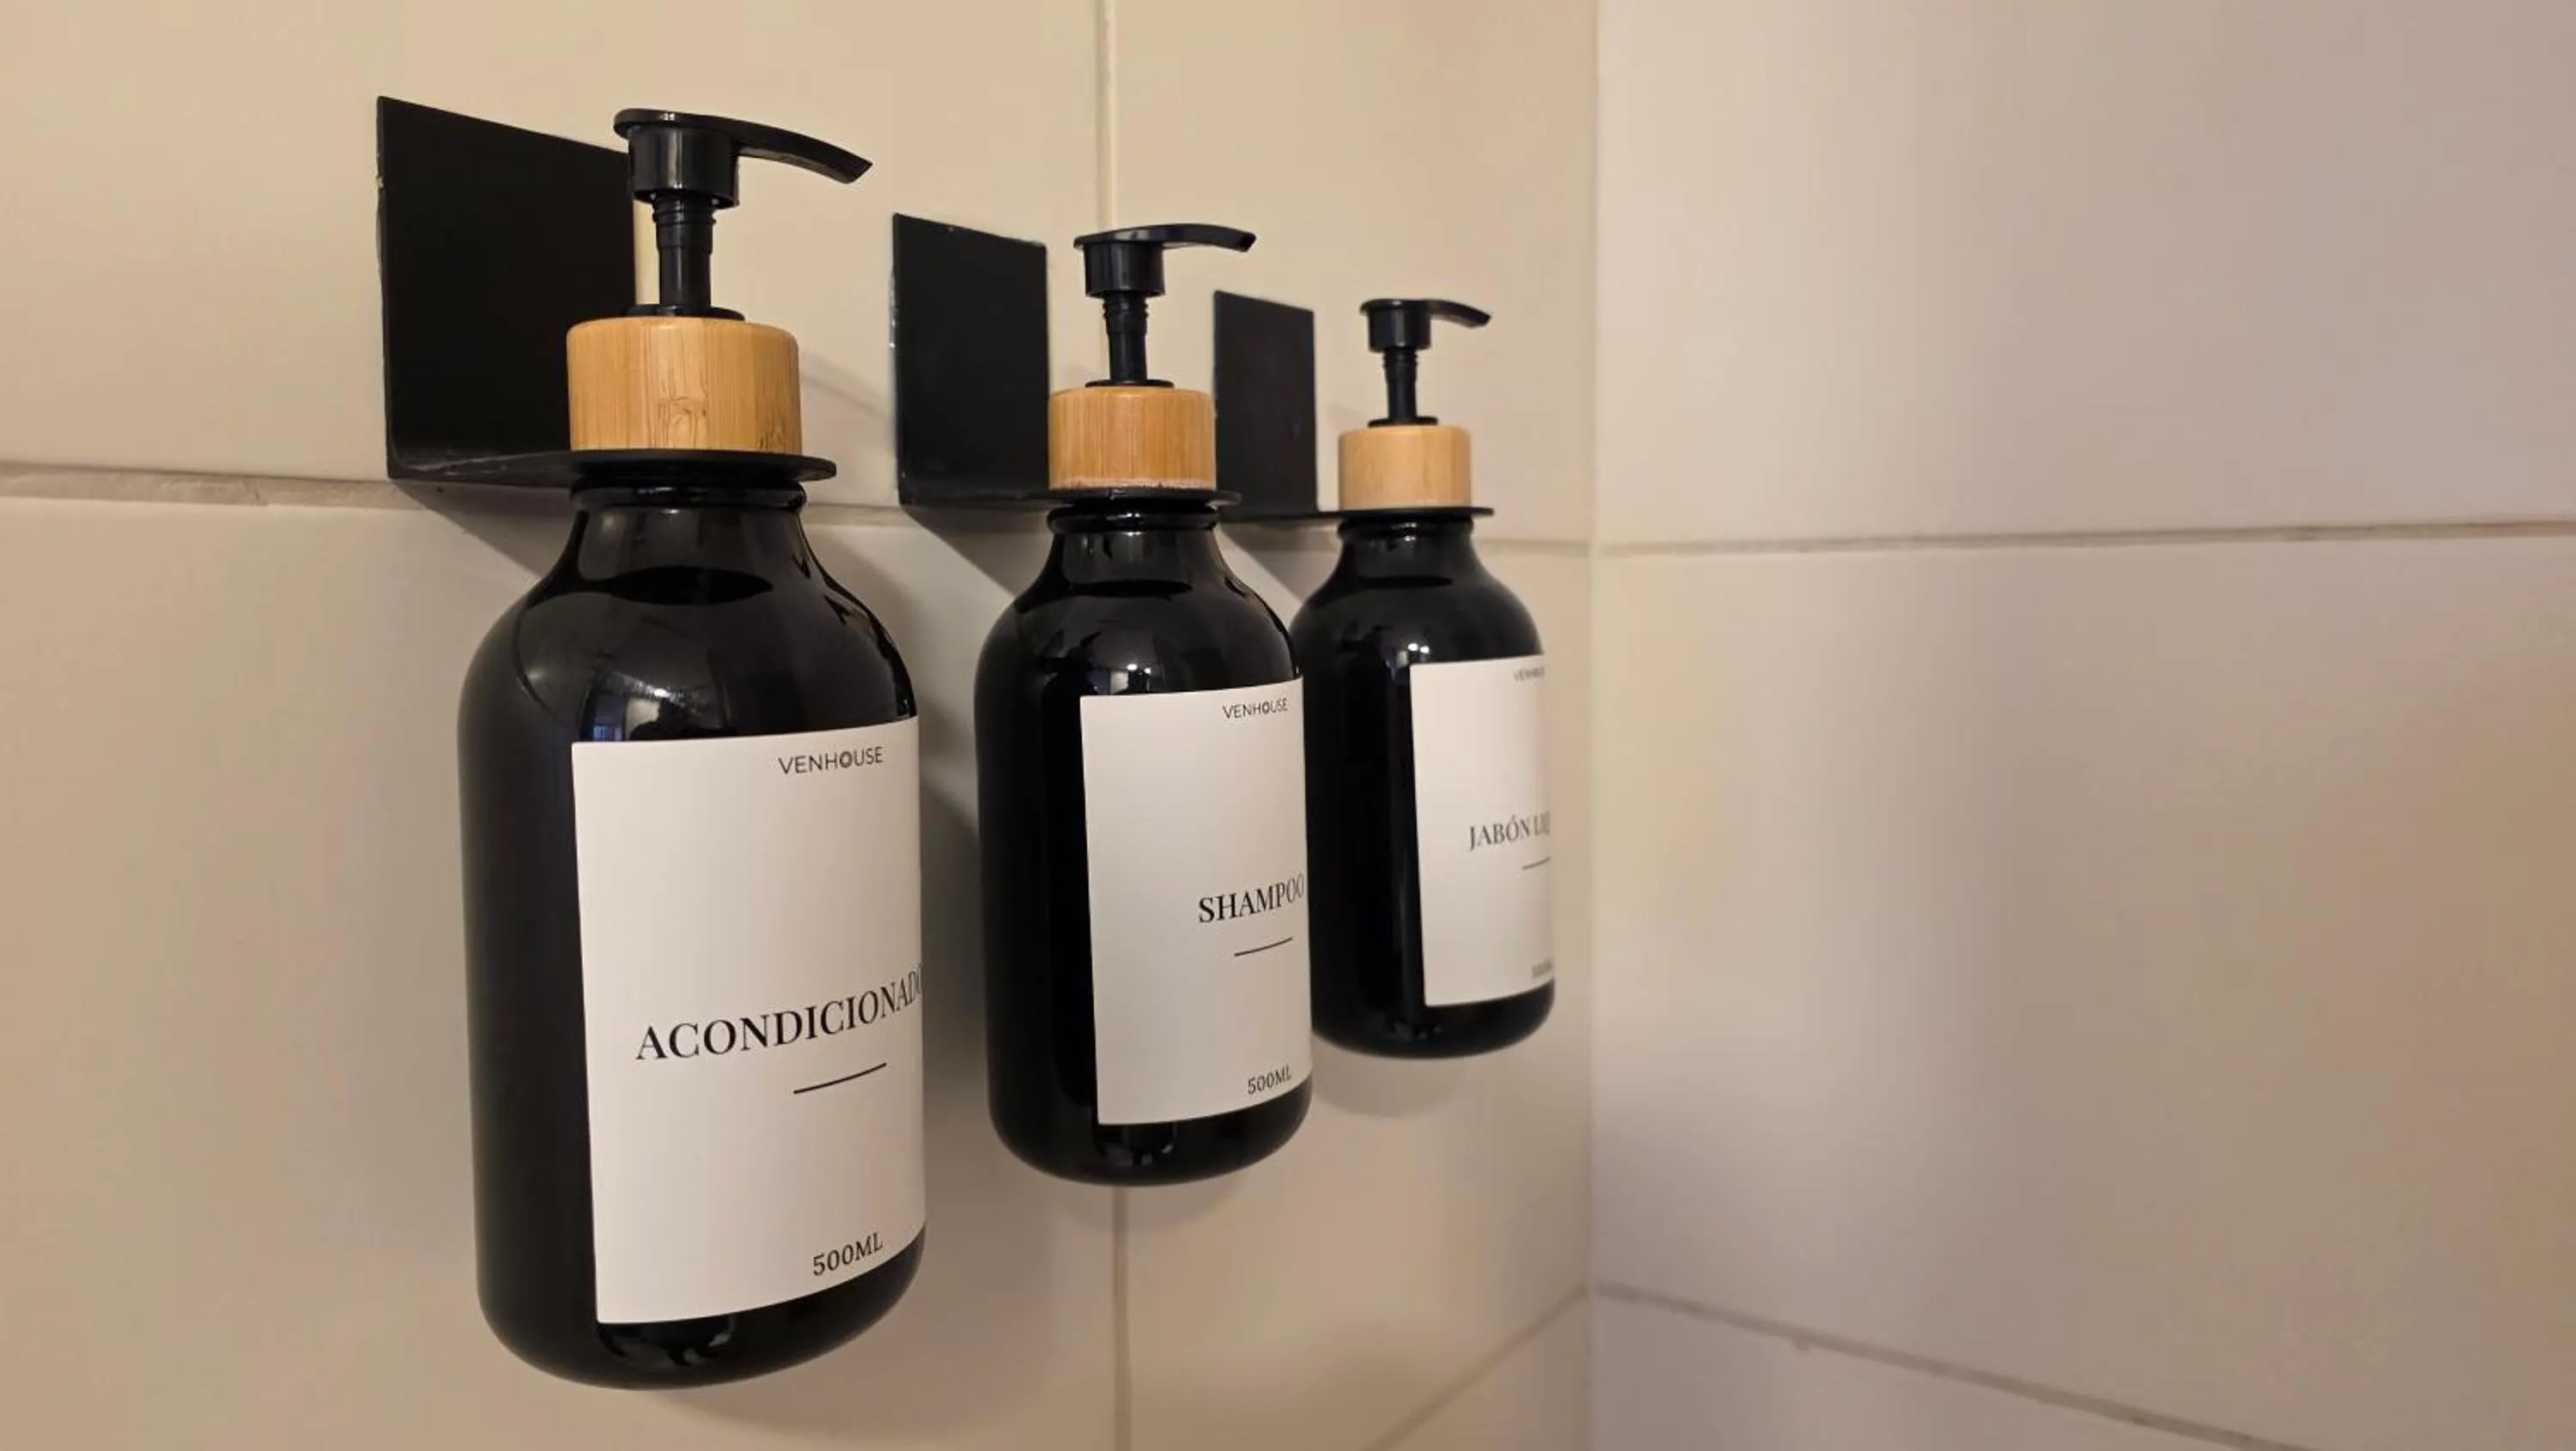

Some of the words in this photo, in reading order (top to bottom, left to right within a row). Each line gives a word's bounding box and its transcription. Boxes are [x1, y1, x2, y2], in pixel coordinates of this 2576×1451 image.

[1222, 697, 1289, 719] VENHOUSE
[778, 746, 884, 774] VENHOUSE
[1468, 814, 1530, 852] JABÓN
[1199, 872, 1304, 923] SHAMPOO
[1248, 1064, 1291, 1095] 500ML
[812, 1231, 884, 1276] 500ML
